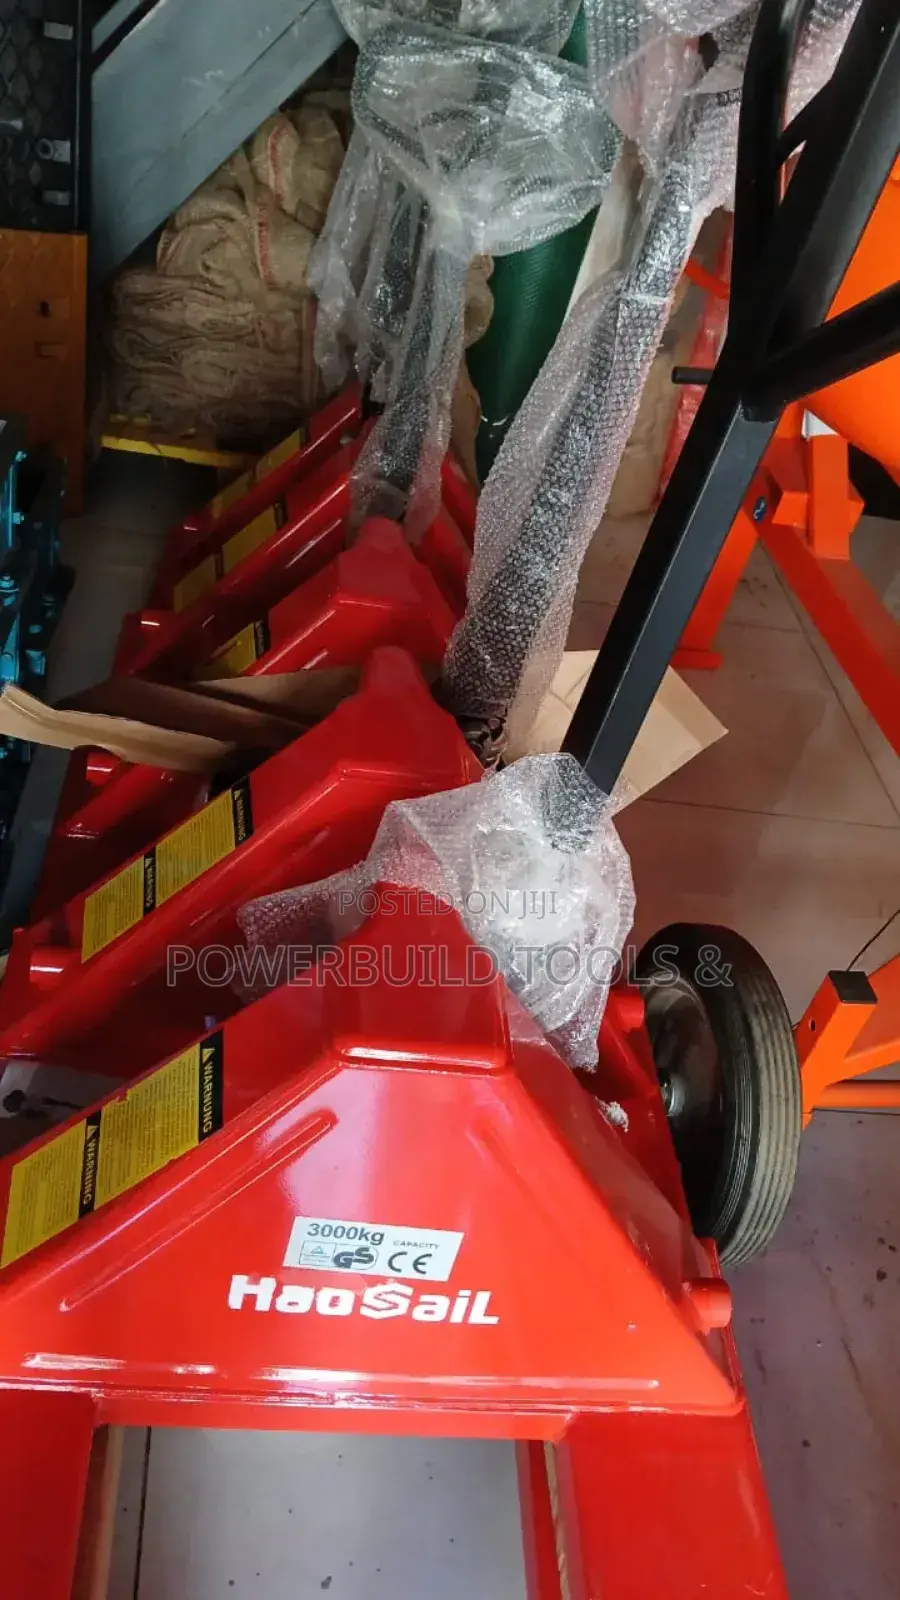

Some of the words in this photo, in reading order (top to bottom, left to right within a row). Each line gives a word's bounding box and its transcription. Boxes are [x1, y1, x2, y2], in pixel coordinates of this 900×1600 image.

[307, 1222, 385, 1246] 3000kg
[393, 1240, 440, 1250] CAPACITY
[333, 1246, 375, 1269] GS
[387, 1251, 433, 1275] CE
